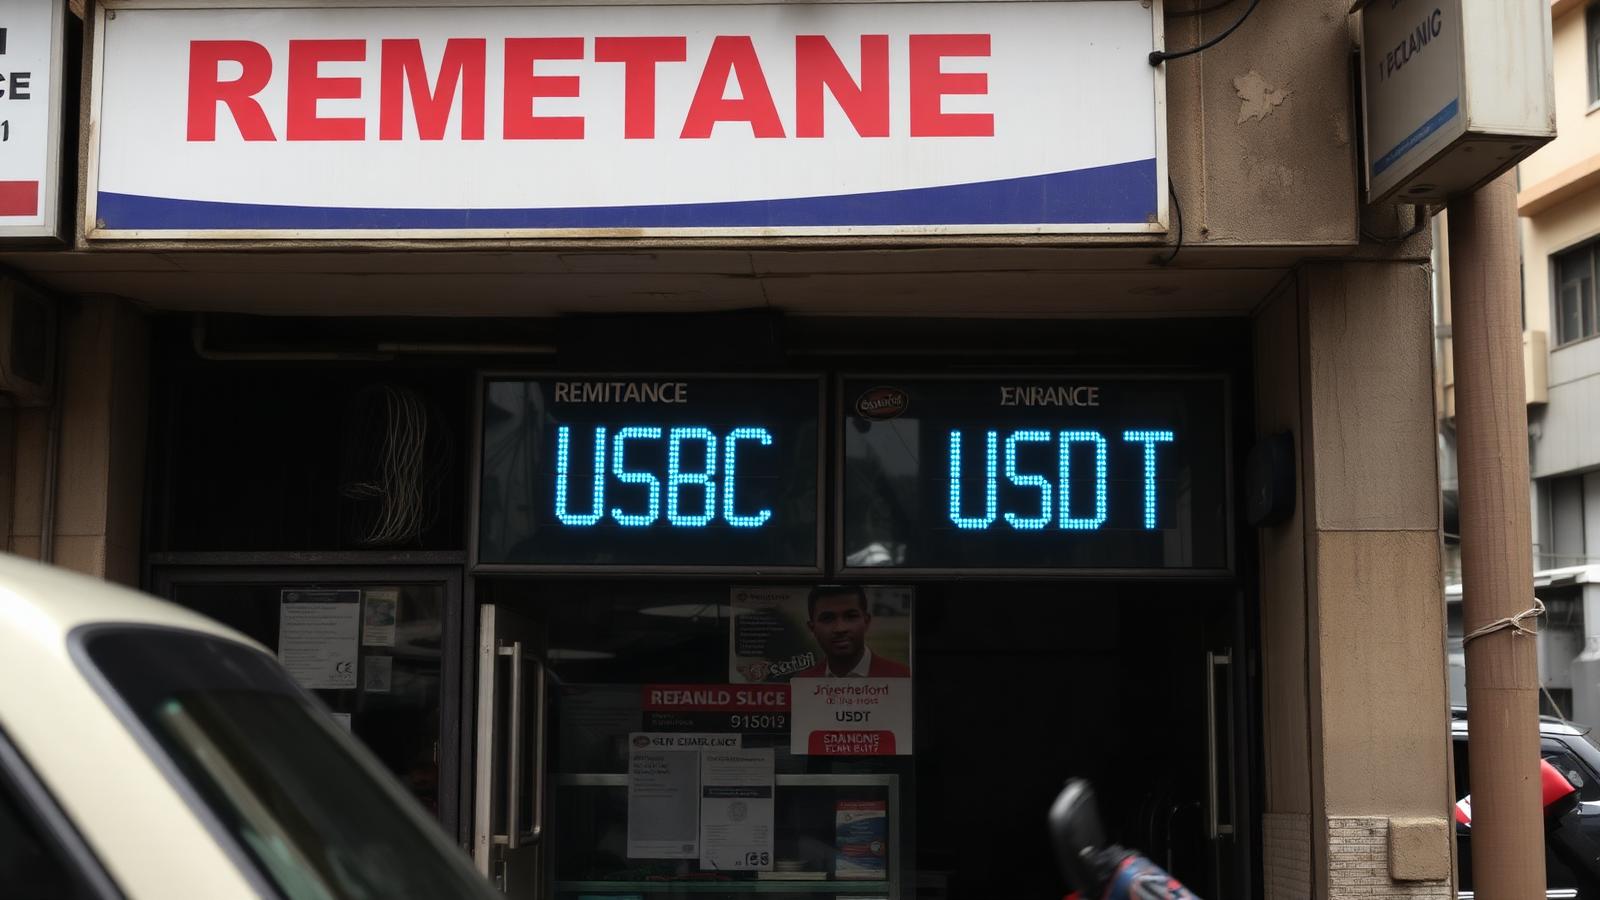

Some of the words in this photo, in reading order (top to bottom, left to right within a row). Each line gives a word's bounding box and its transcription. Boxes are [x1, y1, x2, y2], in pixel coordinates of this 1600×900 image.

[186, 34, 995, 142] REMETANE
[555, 382, 688, 403] REMITANCE
[556, 426, 772, 527] USBC
[949, 430, 1174, 529] USDT
[736, 691, 786, 706] SLICE
[835, 711, 871, 722] USDT
